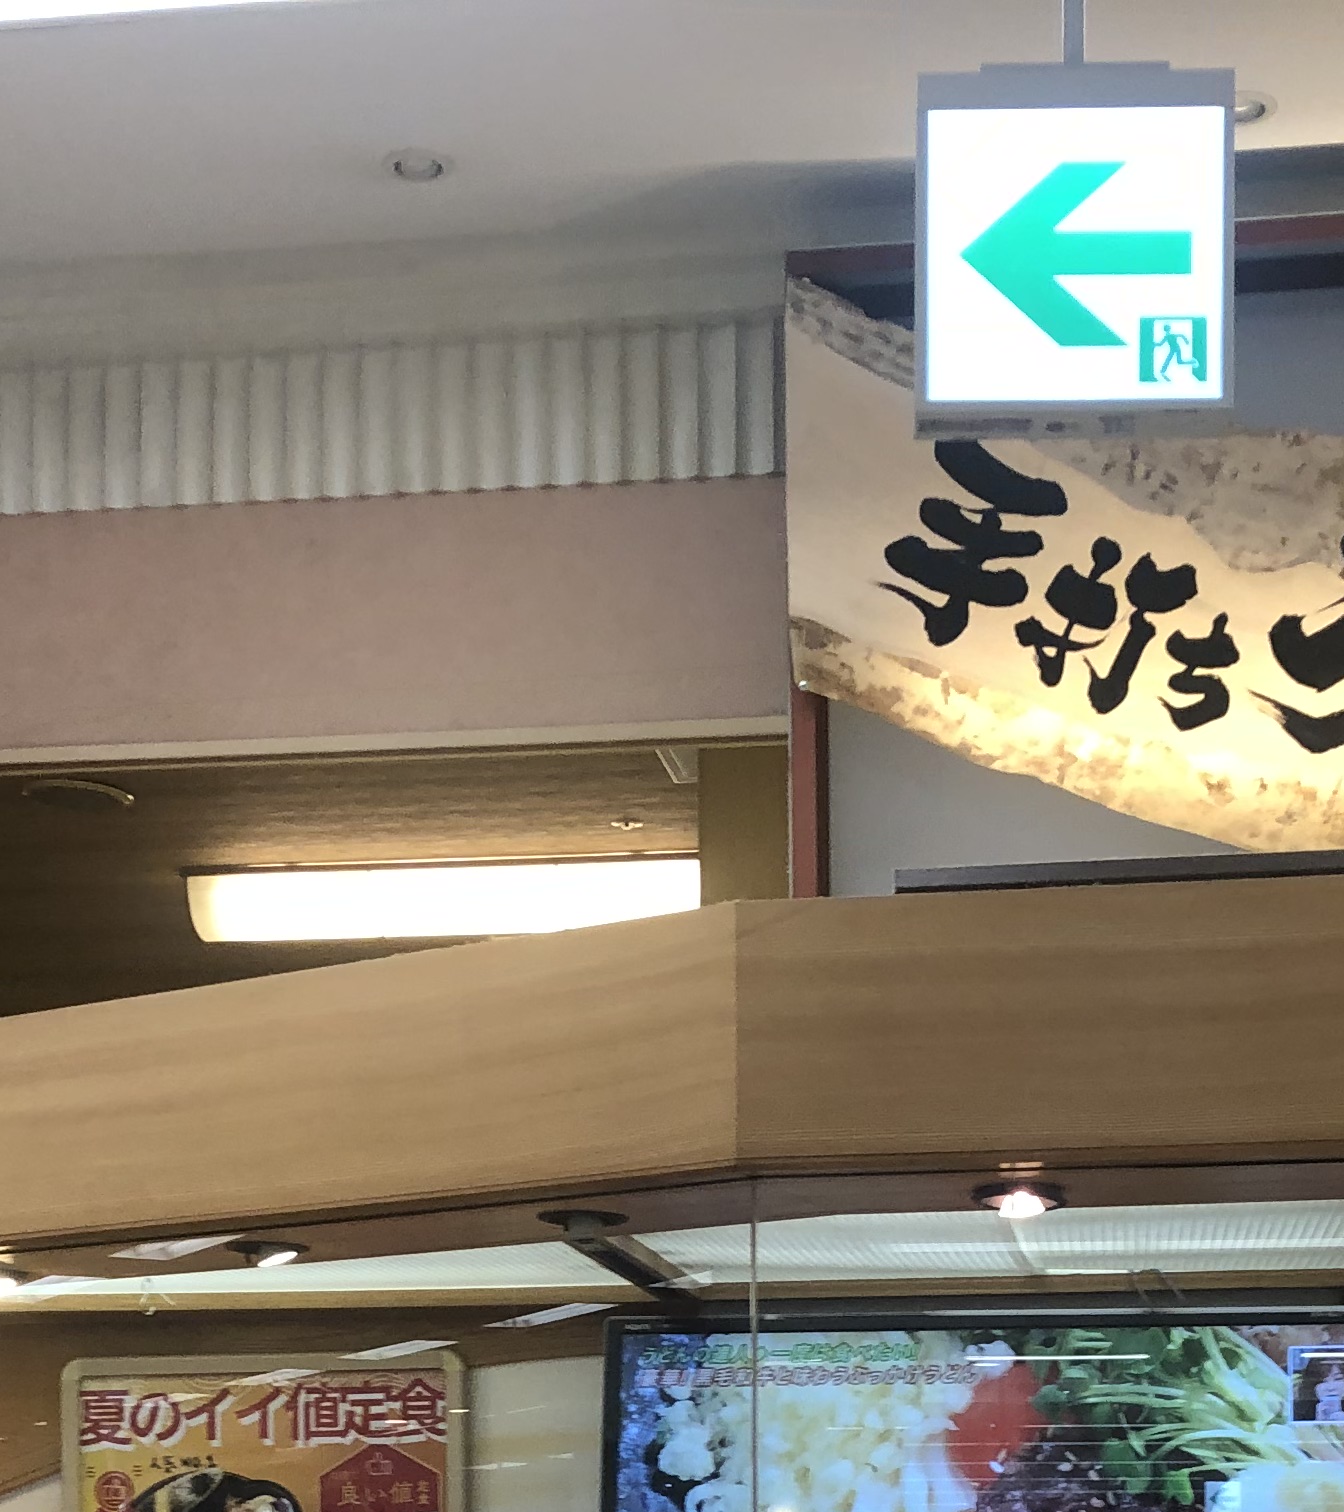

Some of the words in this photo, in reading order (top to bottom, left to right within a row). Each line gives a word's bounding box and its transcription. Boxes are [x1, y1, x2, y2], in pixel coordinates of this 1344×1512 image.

[80, 1378, 448, 1449] 夏のイイ値定食
